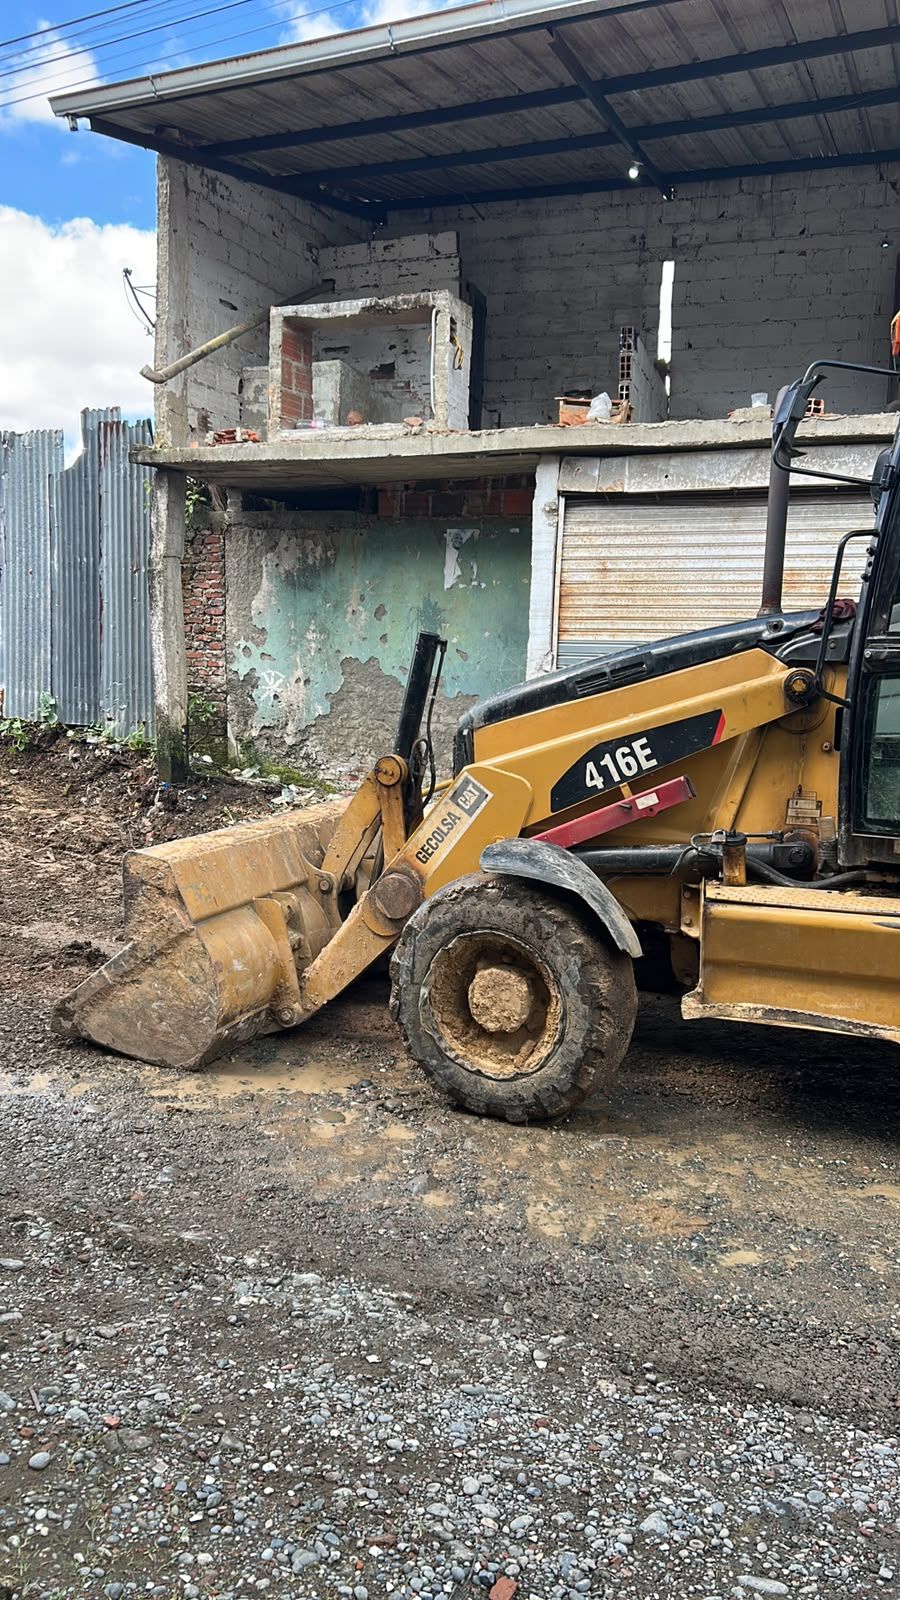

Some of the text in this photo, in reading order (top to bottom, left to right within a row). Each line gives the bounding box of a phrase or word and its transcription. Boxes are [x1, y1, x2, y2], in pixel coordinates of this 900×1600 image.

[585, 737, 658, 789] 416E
[415, 783, 480, 864] GECOLSA CAT
